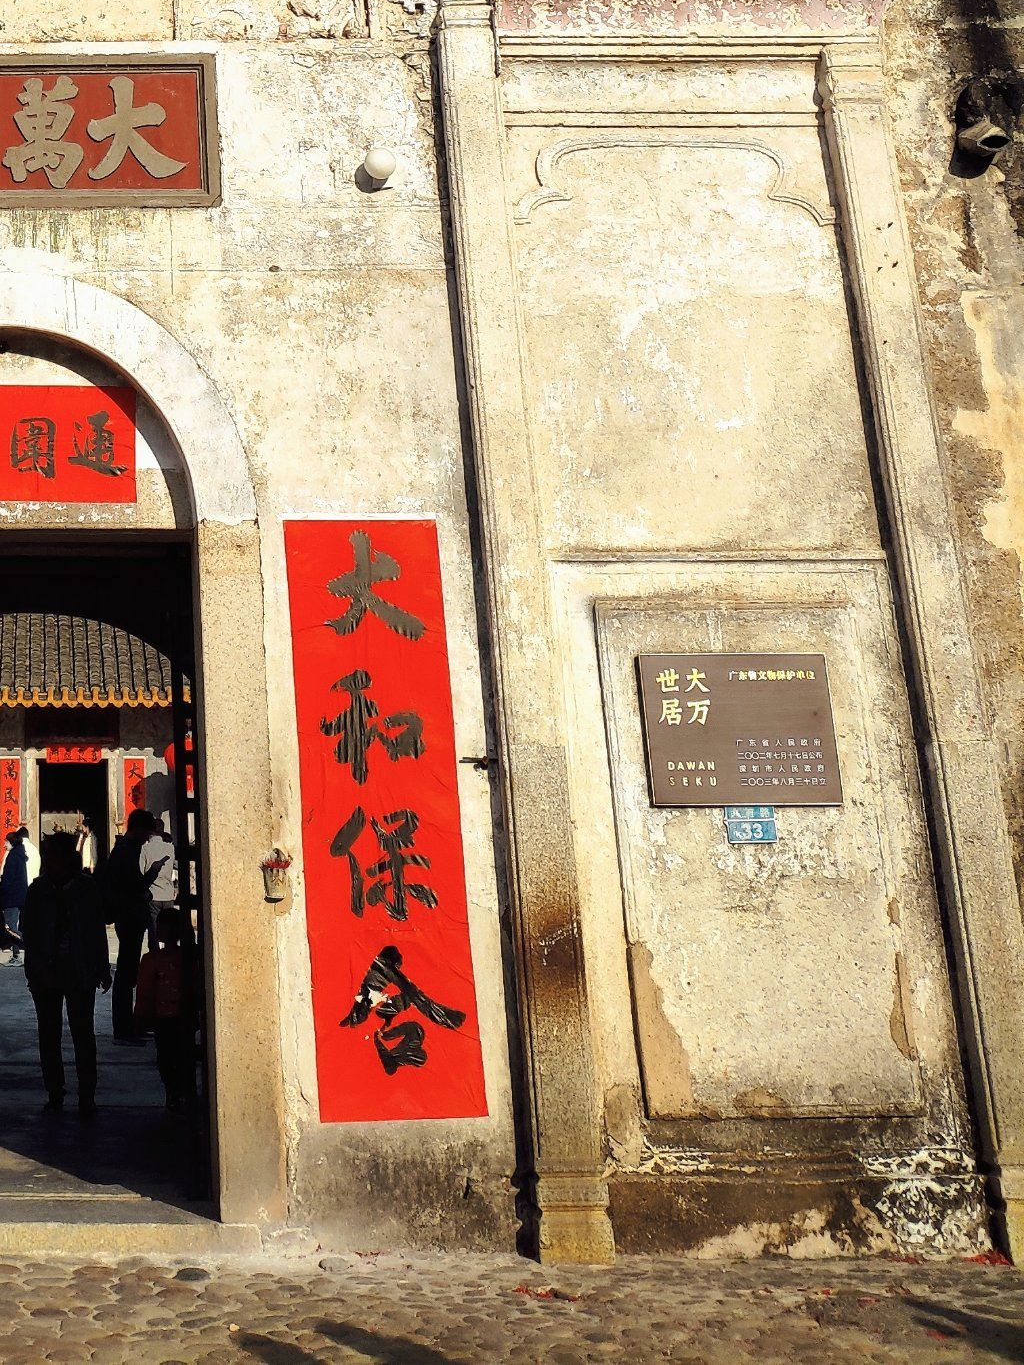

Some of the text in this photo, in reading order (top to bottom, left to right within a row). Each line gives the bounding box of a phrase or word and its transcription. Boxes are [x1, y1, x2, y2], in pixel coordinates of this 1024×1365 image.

[736, 738, 822, 747] 广东省人民政府
[667, 761, 716, 772] DAWAN
[668, 776, 718, 787] SEKU
